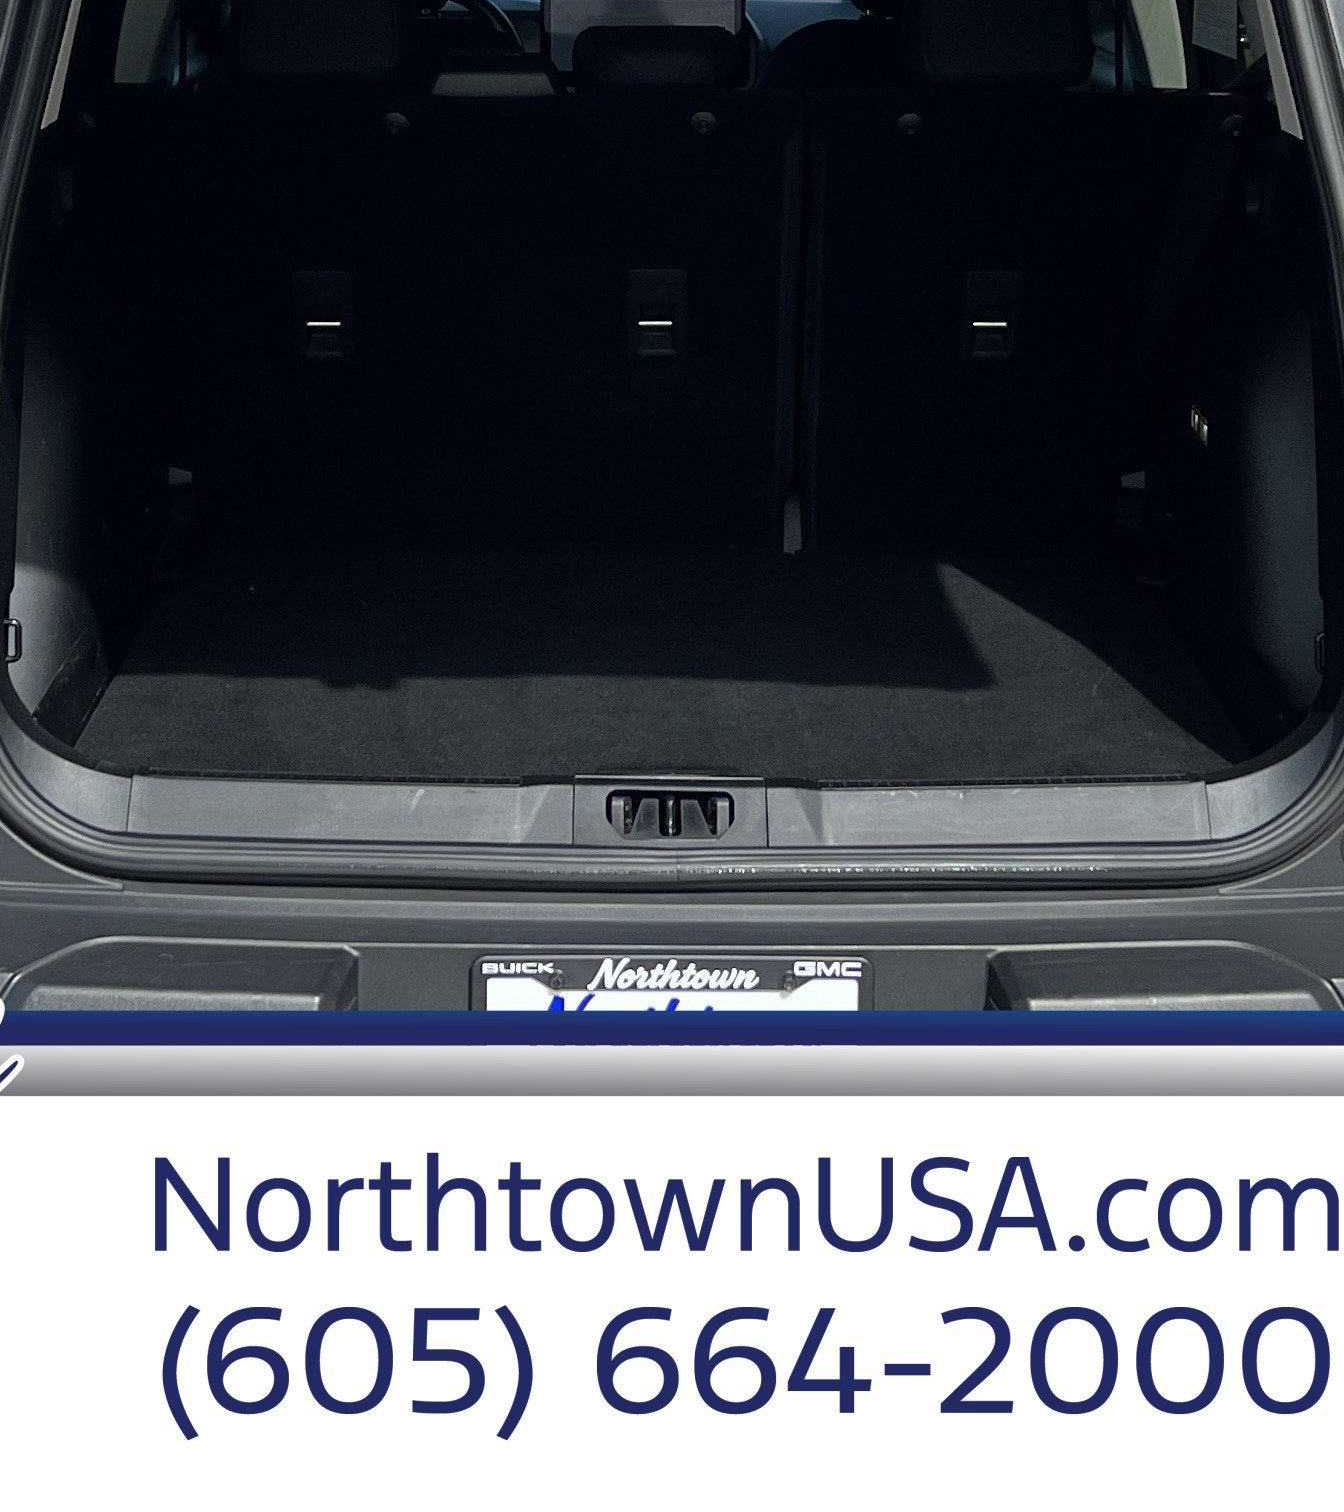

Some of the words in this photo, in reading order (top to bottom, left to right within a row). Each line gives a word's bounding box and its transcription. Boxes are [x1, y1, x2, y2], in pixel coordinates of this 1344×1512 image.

[481, 962, 555, 975] BUICK
[587, 957, 760, 991] Northtown
[793, 961, 863, 977] GMC
